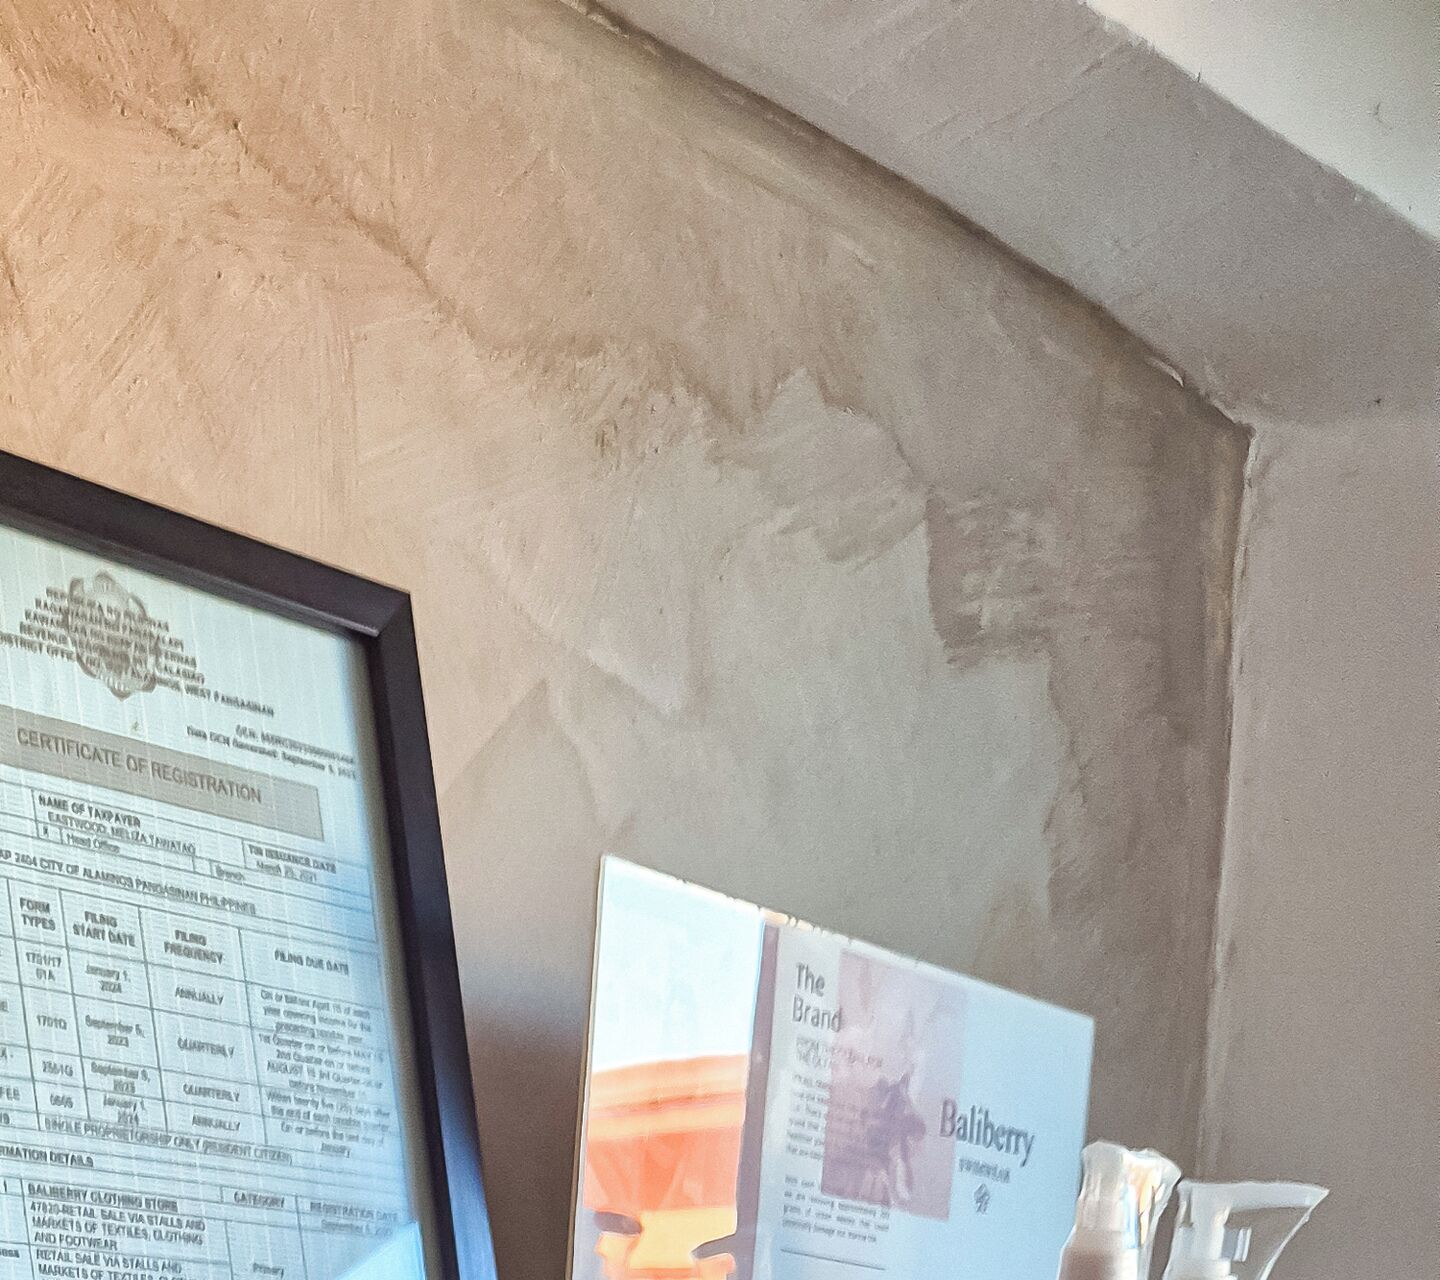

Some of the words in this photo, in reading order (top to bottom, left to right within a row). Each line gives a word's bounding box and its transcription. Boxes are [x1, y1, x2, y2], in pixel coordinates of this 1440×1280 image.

[16, 727, 125, 768] CERTIFICATE
[126, 755, 151, 775] OF
[151, 764, 263, 804] REGISTRATION
[38, 794, 69, 811] NAME
[71, 803, 85, 814] OF
[88, 806, 141, 828] TAXPAYER
[40, 857, 64, 872] CITY
[66, 863, 80, 876] OF
[83, 867, 134, 889] ALAMINOS
[135, 875, 199, 902] PANGASINAN
[19, 896, 50, 914] FORM
[21, 913, 56, 932] TYPES
[84, 910, 118, 928] FILING
[73, 924, 107, 941] START
[108, 929, 136, 948] DATE
[174, 929, 207, 946] FILING
[164, 941, 223, 965] FREQUENCY
[274, 949, 304, 966] FILING
[305, 956, 324, 970] DUE
[326, 960, 349, 976] DATE
[795, 961, 826, 998] The
[792, 995, 843, 1033] Brand
[177, 1036, 235, 1058] QUARTERLY
[939, 1097, 1035, 1168] Baliberry
[49, 1151, 94, 1167] DETAILS
[28, 1182, 88, 1202] BALIBERRY
[90, 1191, 143, 1209] CLOTHING
[144, 1197, 179, 1212] STORE
[32, 1216, 82, 1233] MARKETS
[84, 1222, 99, 1234] OF
[152, 1229, 203, 1246] CLOTHING
[101, 1209, 126, 1222] SALE
[128, 1212, 144, 1224] VIA
[146, 1215, 183, 1229] STALLS
[185, 1219, 206, 1232] AND
[34, 1232, 57, 1245] AND
[59, 1235, 118, 1251] FOOTWEAR
[36, 1249, 73, 1263] RETAIL
[75, 1252, 100, 1266] SALE
[103, 1255, 120, 1268] VIA
[122, 1258, 160, 1272] STALLS
[161, 1262, 182, 1275] AND
[38, 1263, 88, 1280] MARKETS
[90, 1269, 104, 1280] OF
